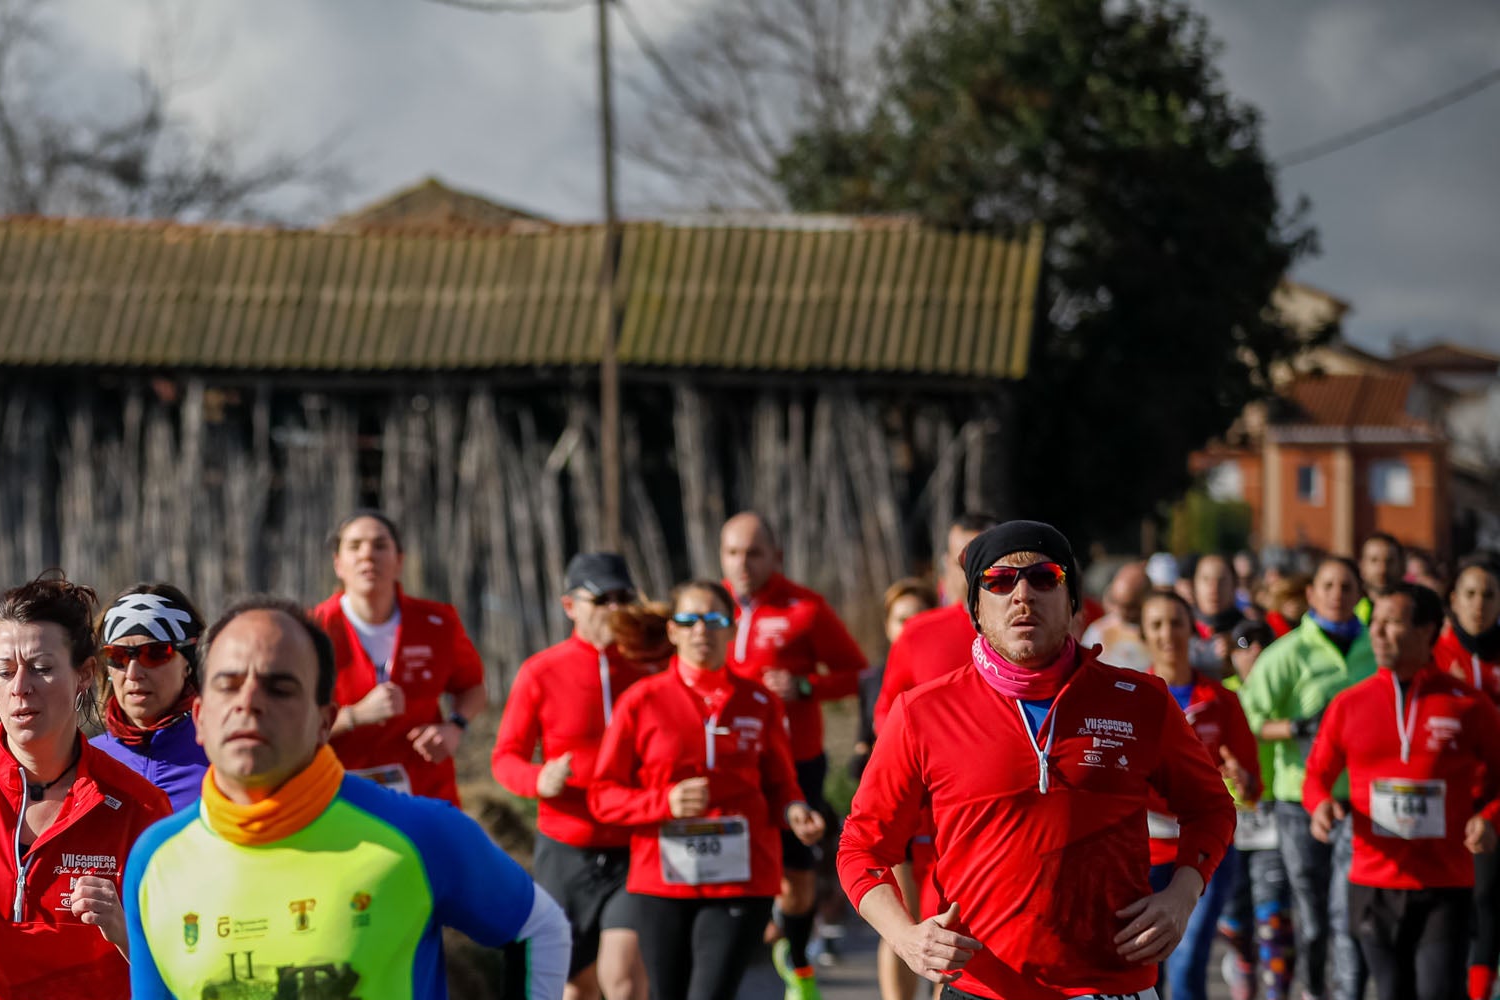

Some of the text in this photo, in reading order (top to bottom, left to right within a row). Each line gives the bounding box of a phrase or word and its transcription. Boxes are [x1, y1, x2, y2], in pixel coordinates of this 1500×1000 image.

[1084, 718, 1133, 729] VII CARRERA
[1097, 724, 1133, 734] POPULAR
[61, 853, 117, 868] VII CARRERA
[74, 861, 117, 870] POPULAR
